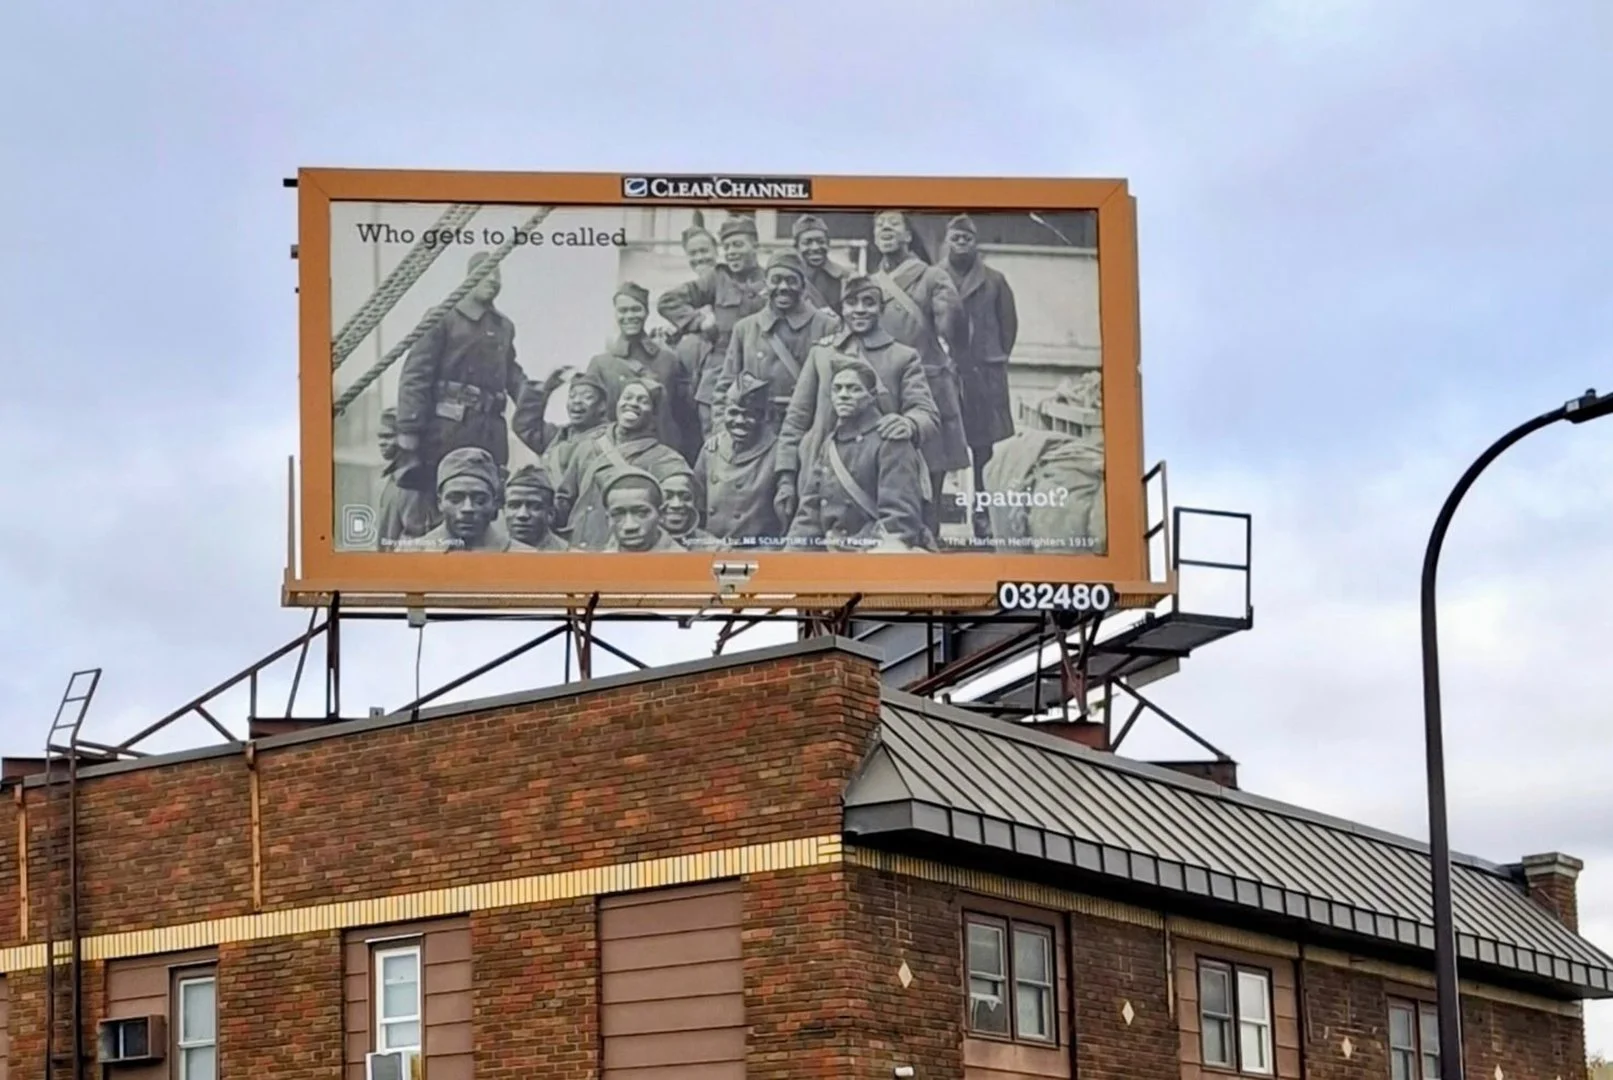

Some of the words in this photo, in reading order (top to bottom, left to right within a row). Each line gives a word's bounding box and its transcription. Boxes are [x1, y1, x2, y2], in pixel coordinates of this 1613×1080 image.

[356, 223, 414, 243] Who
[423, 227, 475, 249] gets
[483, 227, 505, 246] to
[512, 226, 544, 246] be
[551, 228, 628, 247] called
[955, 491, 968, 506] a
[975, 487, 1068, 511] patriot?
[969, 537, 1005, 546] Harlem
[999, 582, 1111, 611] 032480
